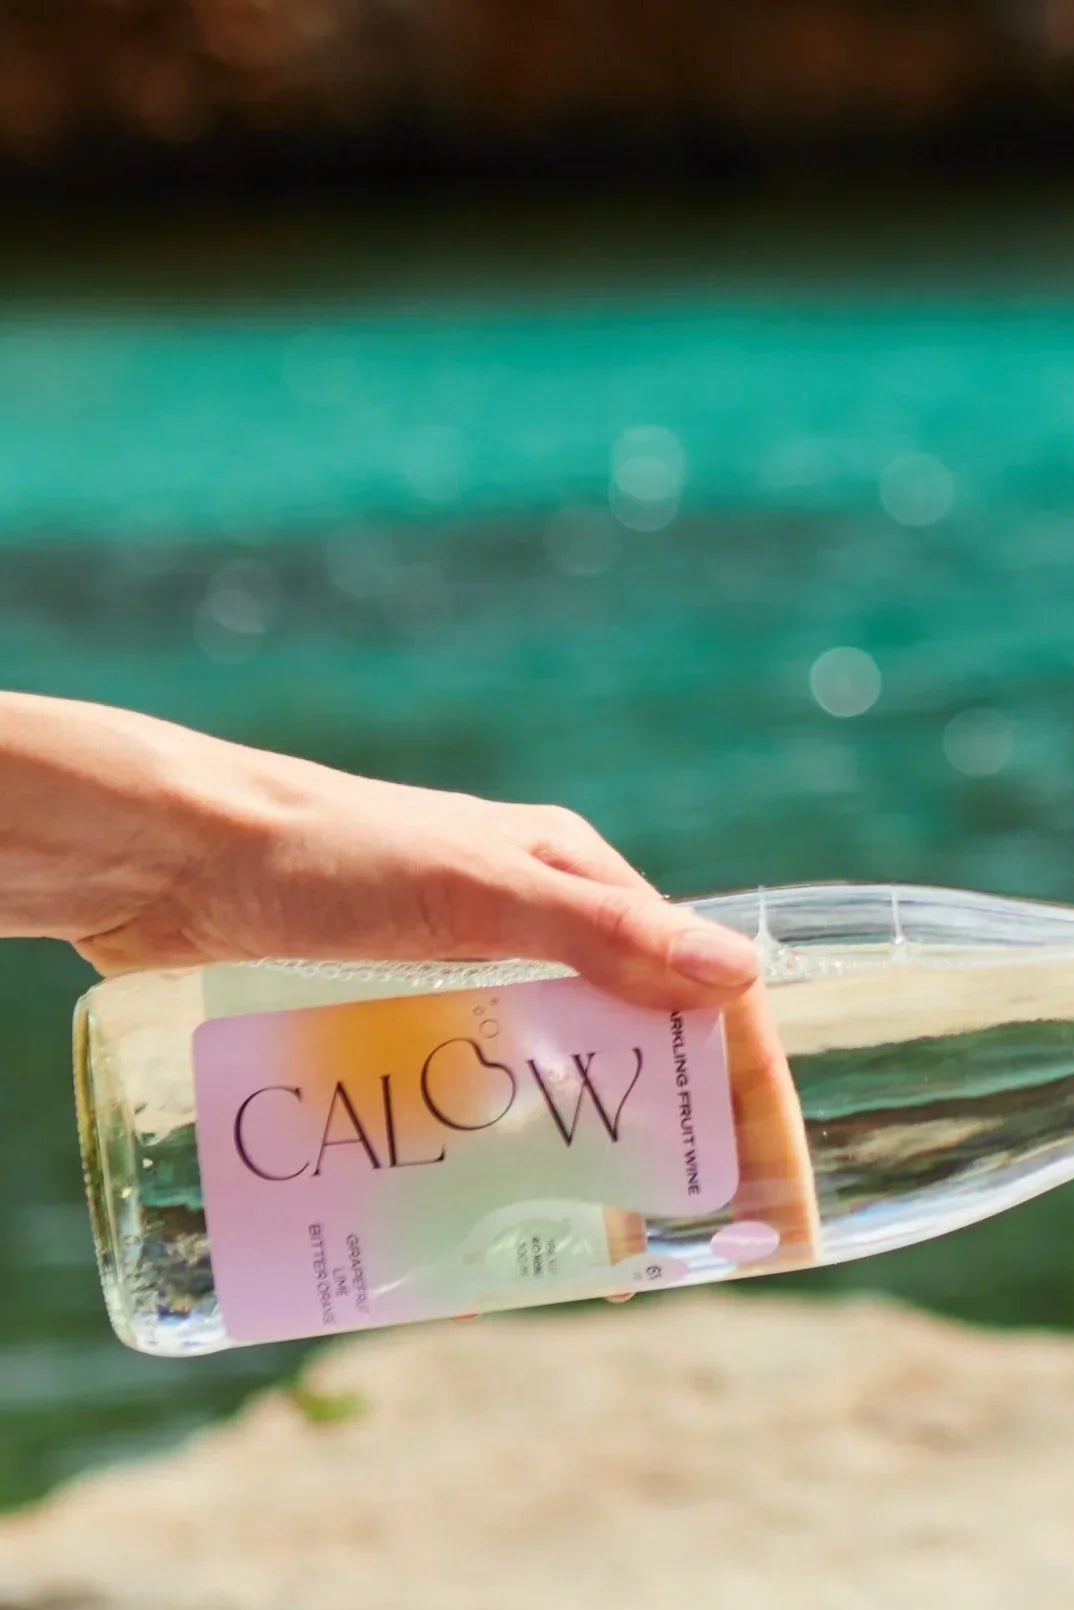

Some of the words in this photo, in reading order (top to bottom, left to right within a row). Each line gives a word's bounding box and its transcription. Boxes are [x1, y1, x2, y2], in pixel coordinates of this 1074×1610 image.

[669, 1010, 689, 1088] RKLING
[233, 1036, 643, 1182] CALOW
[677, 1091, 696, 1146] FRUIT
[684, 1150, 702, 1196] WINE
[308, 1223, 328, 1280] BITTER
[332, 1268, 348, 1298] LIME
